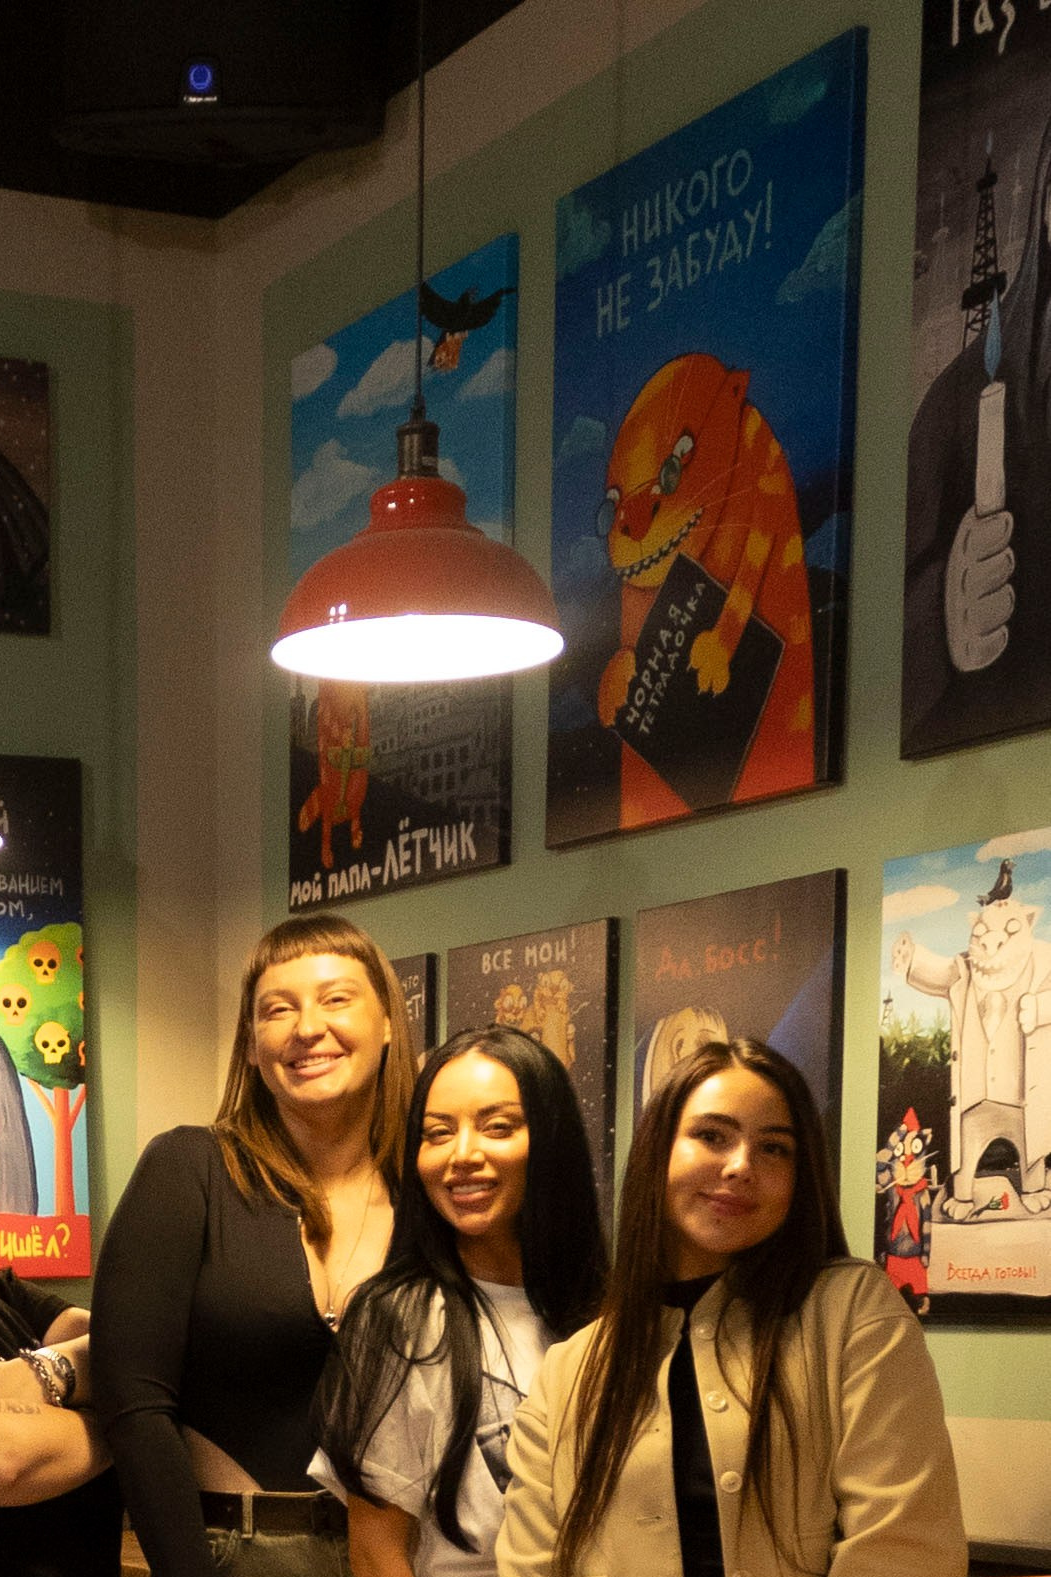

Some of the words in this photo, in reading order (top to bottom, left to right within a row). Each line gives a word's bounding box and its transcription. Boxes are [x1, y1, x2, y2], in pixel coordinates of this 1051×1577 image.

[597, 272, 632, 338] НЕ
[647, 180, 773, 312] ЗАБУДУ!
[622, 149, 754, 257] НИКОГО
[626, 603, 682, 726] ЧОРНАЯ
[638, 581, 706, 735] ТЕТРАДОЧКА
[290, 872, 322, 906] МОЙ
[481, 948, 512, 975] ВСЕ
